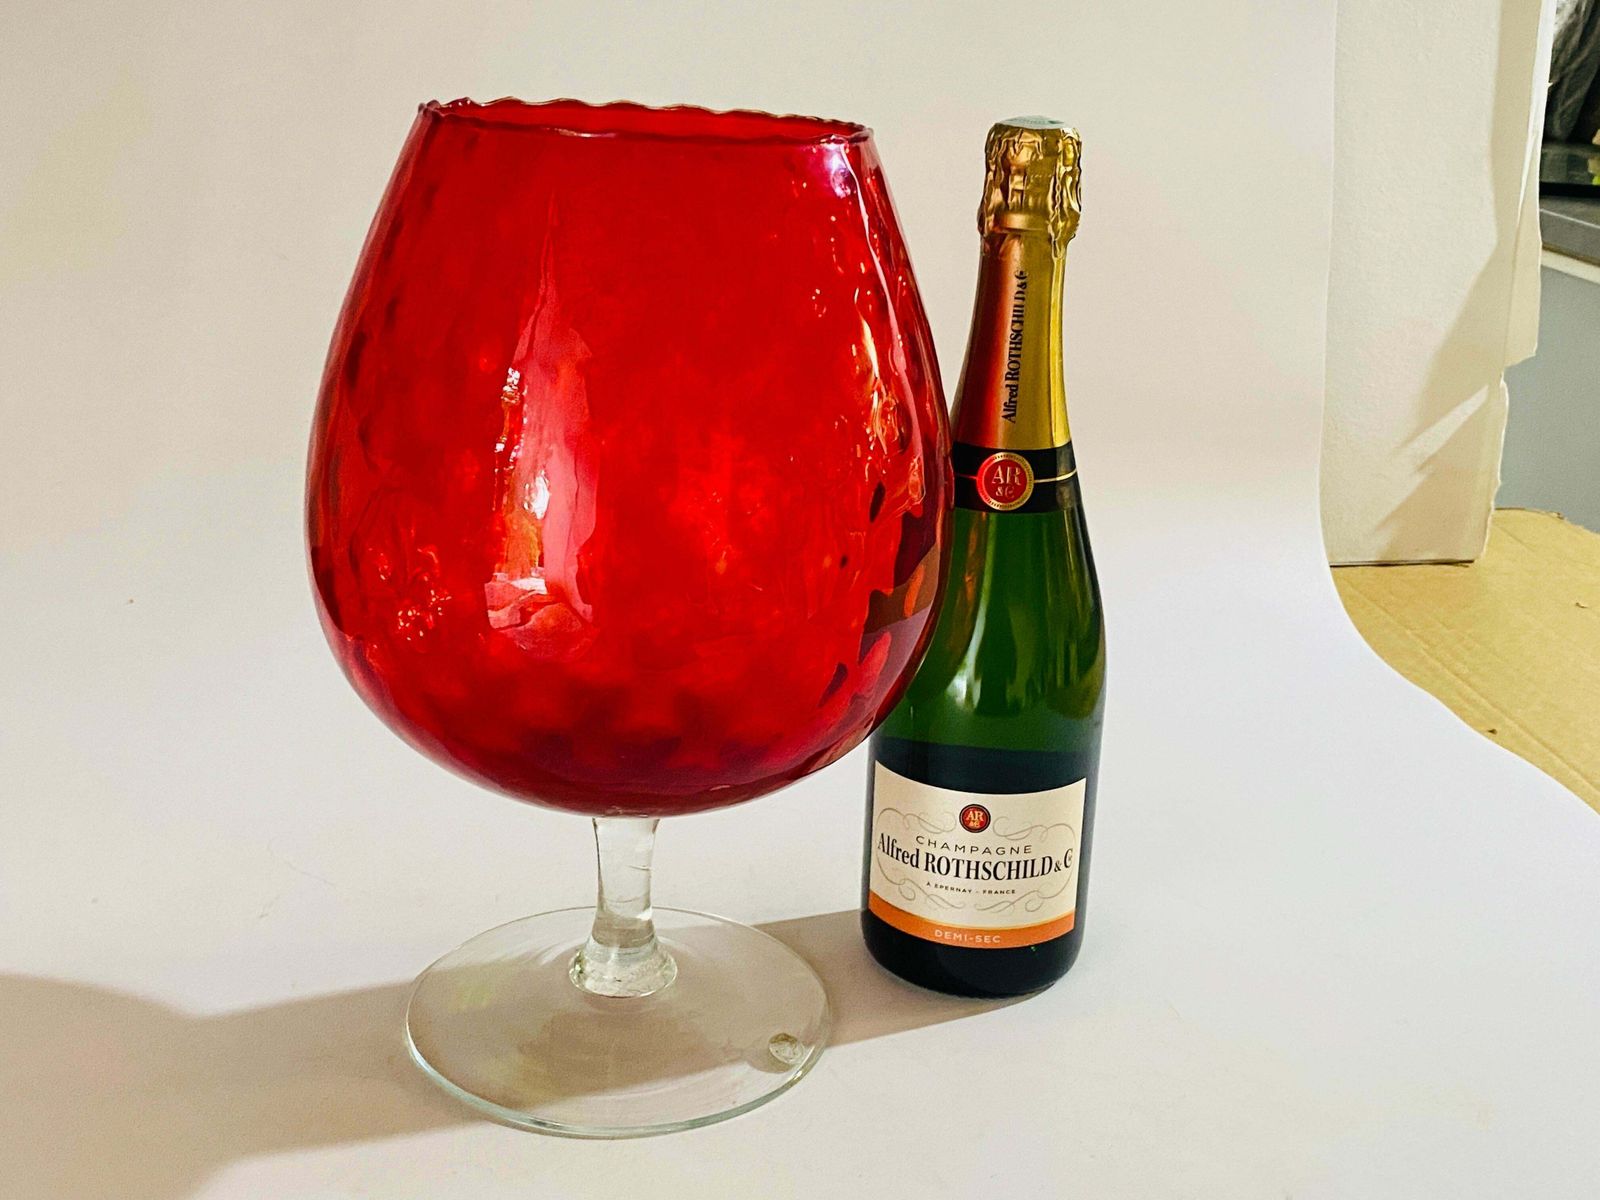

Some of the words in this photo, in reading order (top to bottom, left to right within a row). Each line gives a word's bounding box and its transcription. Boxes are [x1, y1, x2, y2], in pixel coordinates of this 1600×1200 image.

[1005, 290, 1026, 382] ROTHSCHILD
[1001, 383, 1019, 424] Alfred
[992, 466, 1021, 486] AR
[966, 810, 984, 822] AR
[915, 835, 1033, 855] CHAMPAGNE
[878, 832, 920, 869] Alfred
[924, 852, 1053, 881] ROTHSCHILD
[934, 929, 1001, 944] DEMI-SEC
